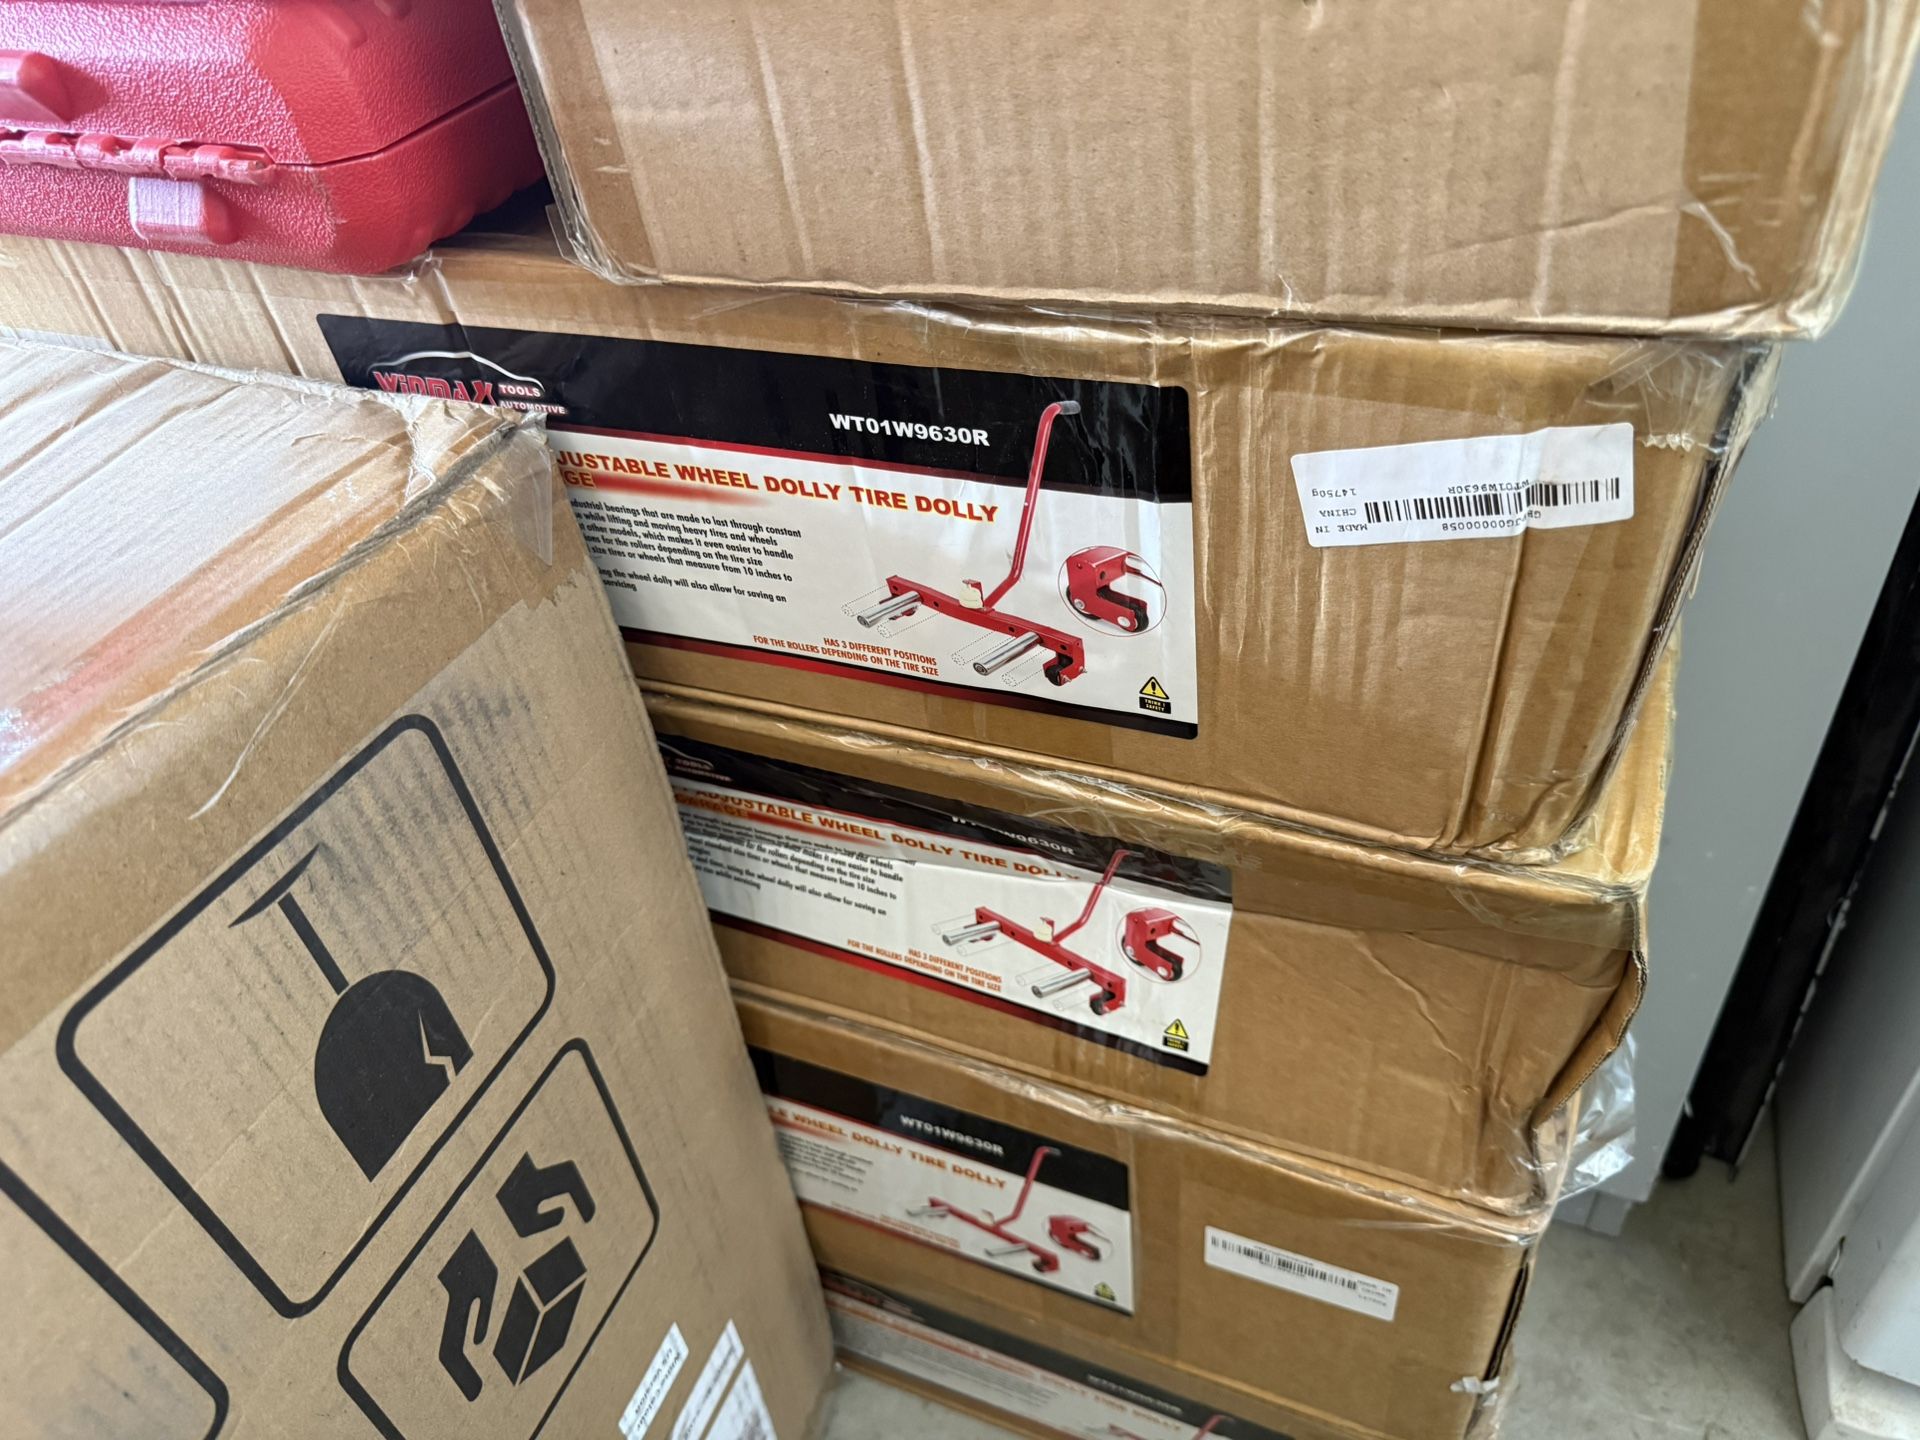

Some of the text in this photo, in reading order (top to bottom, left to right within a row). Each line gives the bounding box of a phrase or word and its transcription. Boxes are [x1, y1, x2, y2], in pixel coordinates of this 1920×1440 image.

[499, 384, 541, 398] TOOLS
[500, 400, 566, 415] AUTOMOTIVE
[828, 412, 991, 447] WT01W9630R
[560, 470, 595, 488] GE
[674, 463, 759, 491] WHEEL
[763, 475, 841, 501] DOLLY
[848, 485, 908, 511] TIRE
[914, 494, 998, 523] DOLLY
[1311, 486, 1358, 498] 14750g
[584, 511, 778, 546] while lifting and moving heavy tires and wheels
[604, 503, 640, 517] bearings
[641, 508, 659, 519] that
[660, 511, 674, 520] are
[676, 513, 700, 524] made
[702, 516, 712, 525] to
[712, 516, 729, 528] last
[730, 518, 764, 534] through
[765, 526, 802, 538] constant
[1314, 522, 1368, 534] MADE IN
[1318, 507, 1358, 518] CHINA
[586, 522, 794, 560] other models, which makes it even easier to handle
[601, 535, 614, 545] for
[614, 538, 629, 547] the
[630, 540, 656, 551] rollers
[657, 543, 701, 560] depending
[702, 551, 714, 560] on
[714, 551, 729, 561] the
[730, 554, 745, 564] tire
[746, 556, 763, 566] size
[591, 546, 607, 555] size
[607, 547, 626, 558] tires
[637, 551, 666, 563] wheels
[666, 556, 684, 566] that
[685, 559, 720, 571] measure
[721, 562, 742, 575] from
[743, 566, 754, 576] 10
[755, 568, 783, 580] inches
[783, 573, 793, 582] to
[613, 568, 627, 578] the
[627, 571, 652, 582] wheel
[652, 574, 673, 587] dolly
[673, 578, 689, 588] will
[690, 580, 708, 590] also
[709, 583, 732, 593] allow
[733, 585, 745, 596] for
[746, 590, 775, 603] saving
[776, 594, 787, 603] an
[752, 635, 940, 677] FOR THE ROLLERS DEPENDING ON THE TIRE SIZE
[823, 637, 937, 667] HAS 3 DIFFERENT POSITIONS
[817, 815, 886, 842] WHEEL
[891, 832, 956, 856] DOLLY
[959, 849, 1008, 869] TIRE
[789, 854, 826, 872] depending
[836, 866, 848, 877] the
[862, 873, 876, 884] size
[870, 865, 878, 875] to
[879, 869, 904, 882] handle
[857, 881, 866, 891] 10
[866, 884, 889, 898] inches
[889, 891, 898, 900] to
[900, 1113, 1006, 1157] WT01W9630R
[851, 1131, 903, 1155] DOLLY
[910, 1149, 948, 1171] TIRE
[952, 1162, 1007, 1190] DOLLY
